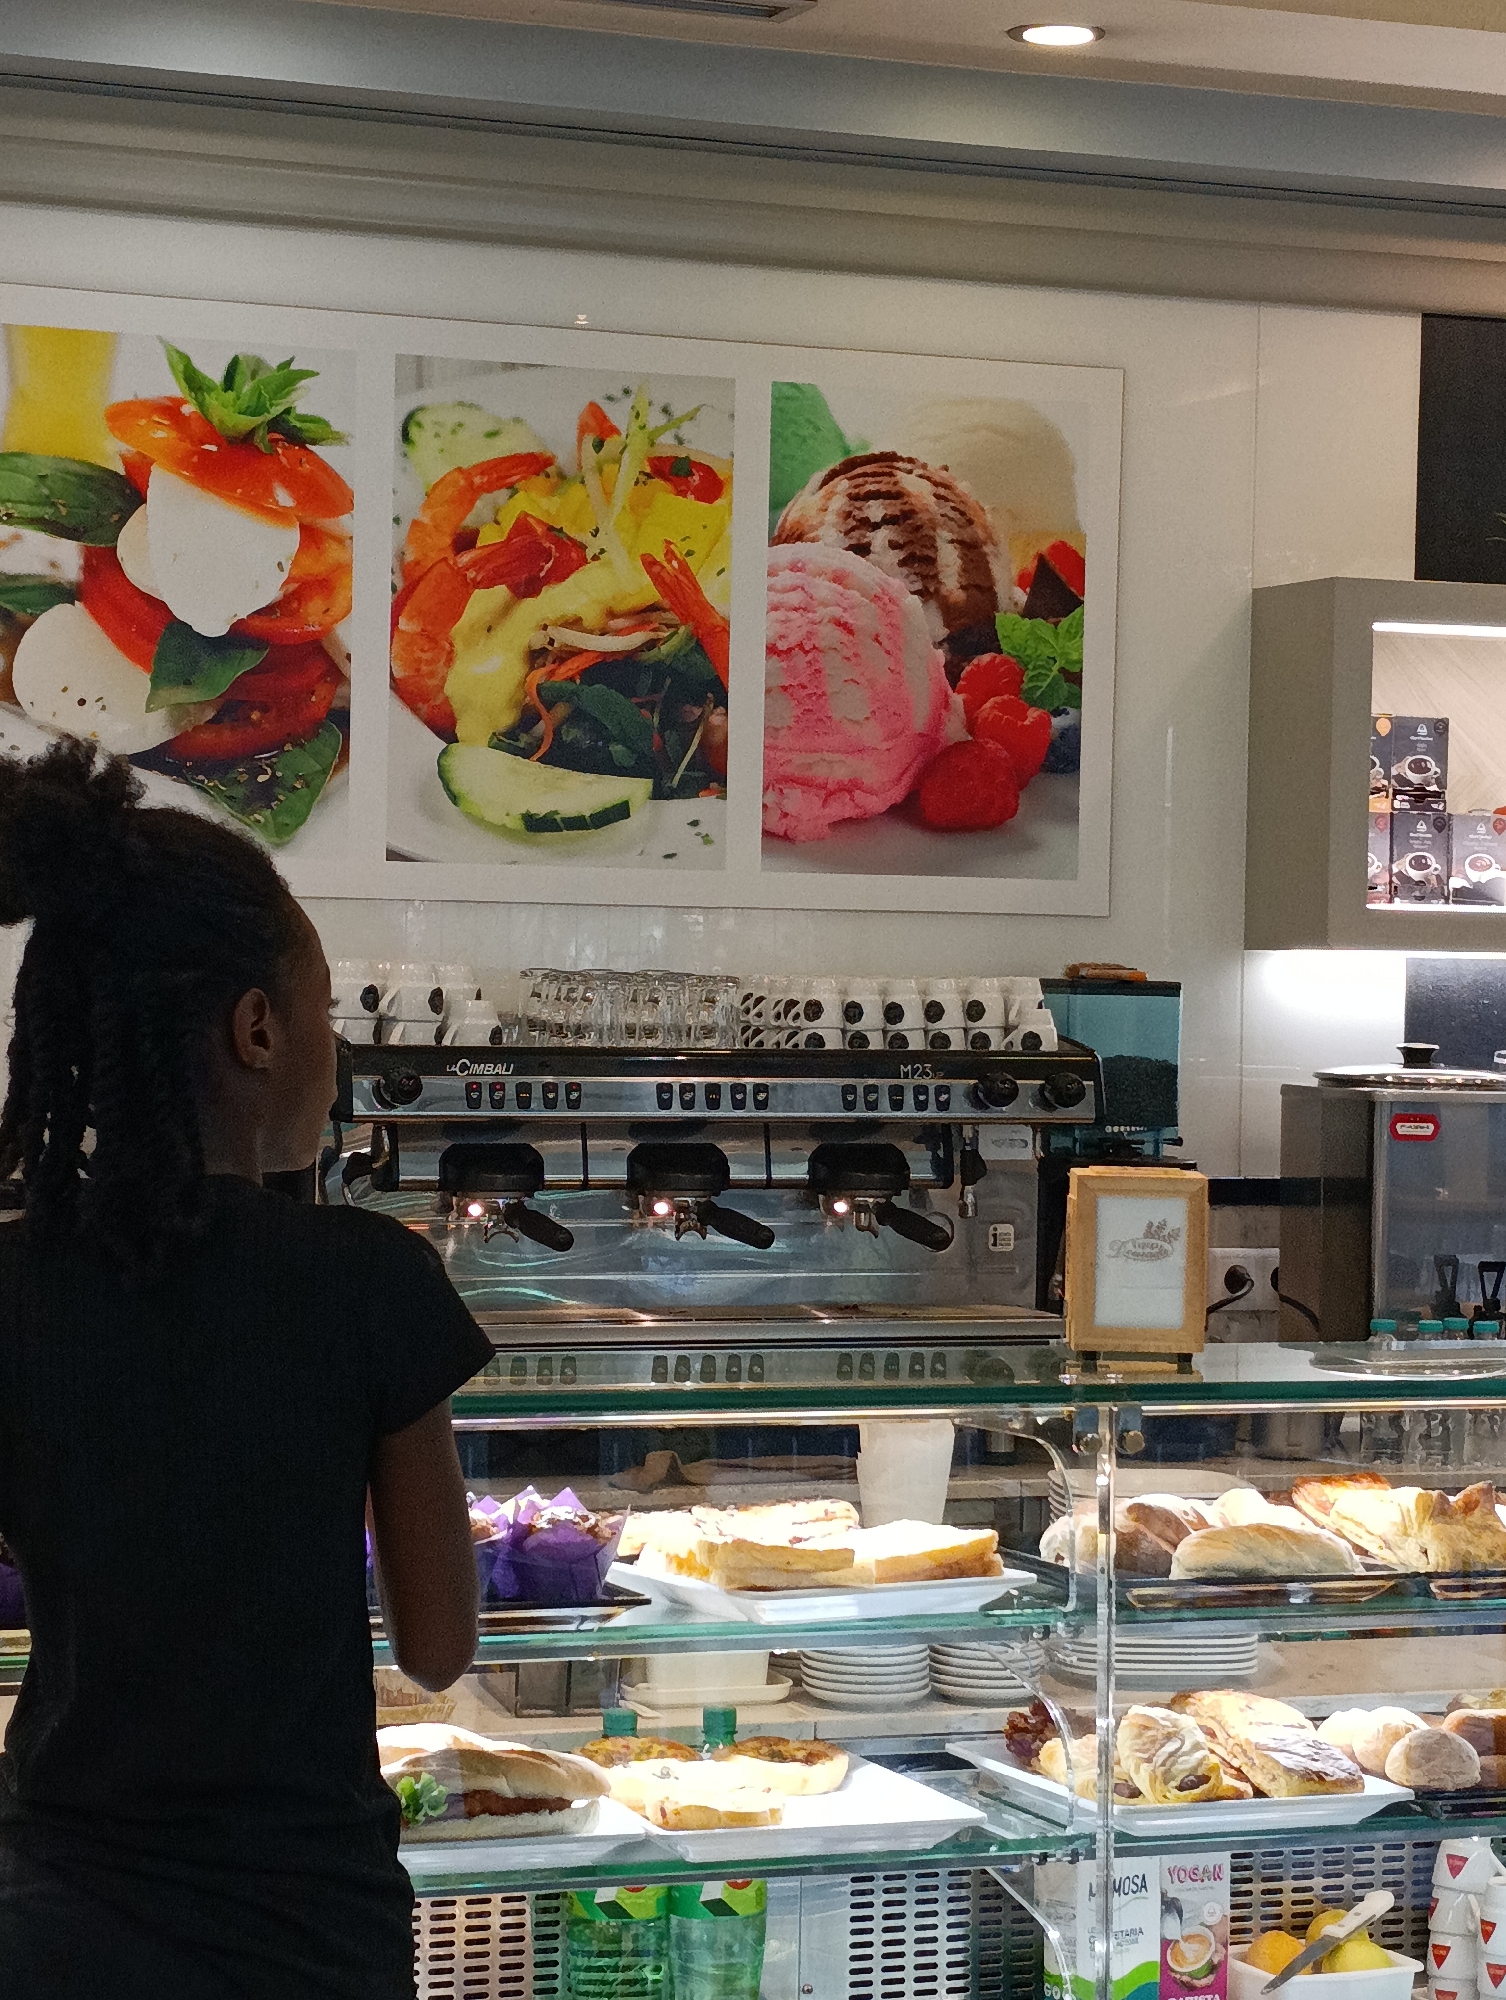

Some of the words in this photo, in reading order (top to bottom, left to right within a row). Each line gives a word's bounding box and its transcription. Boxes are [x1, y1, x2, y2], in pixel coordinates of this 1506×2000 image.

[456, 1058, 514, 1076] CIMBALI
[900, 1063, 932, 1079] M23
[1088, 1873, 1148, 1902] MMOSA
